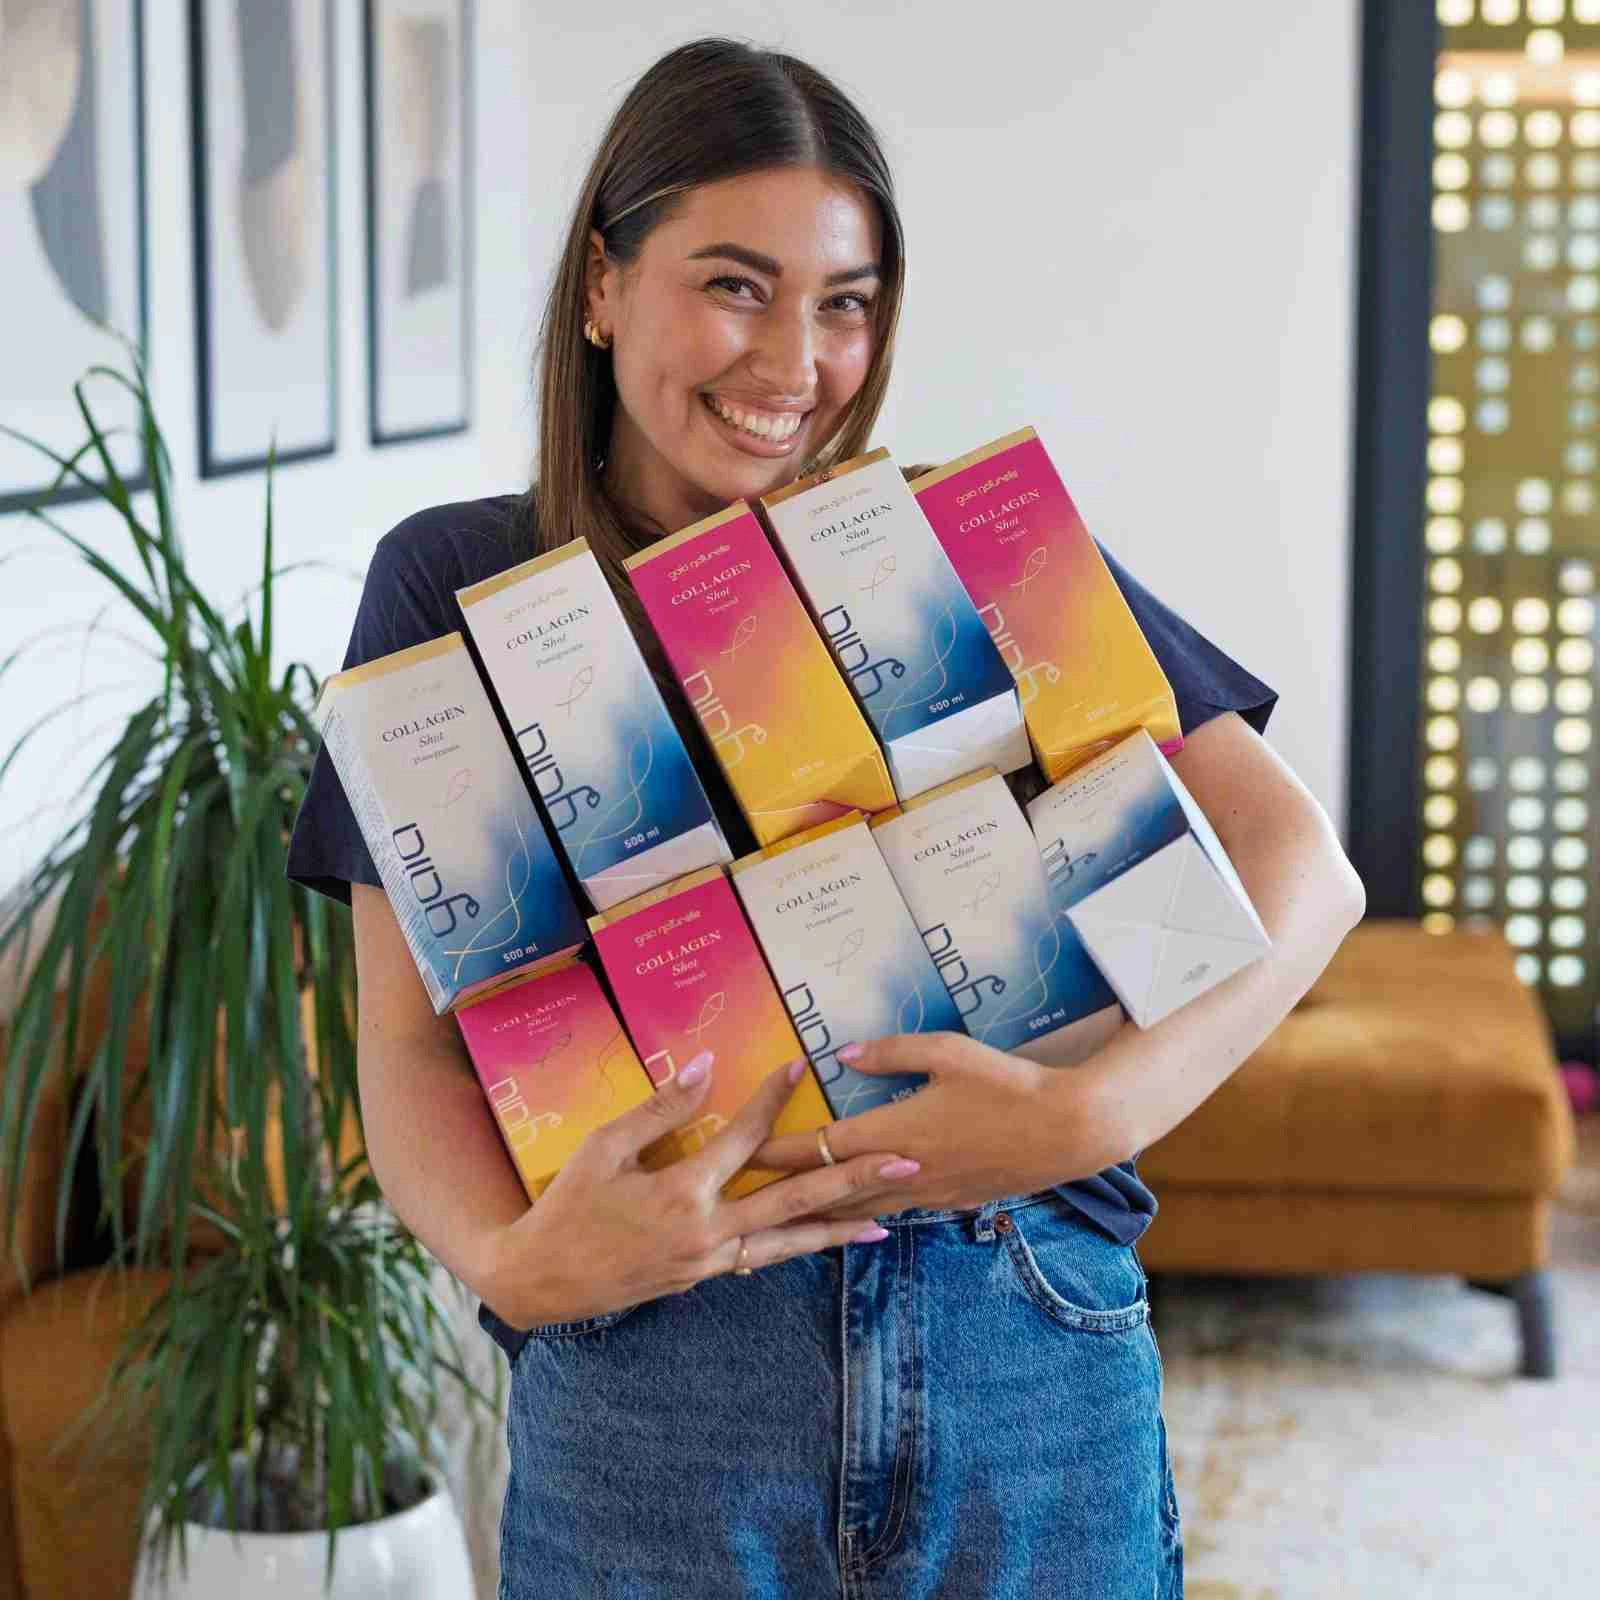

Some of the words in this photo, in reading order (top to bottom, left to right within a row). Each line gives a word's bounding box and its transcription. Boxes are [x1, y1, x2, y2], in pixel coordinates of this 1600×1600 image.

[810, 502, 893, 543] COLLAGEN
[959, 488, 1041, 534] COLLAGEN
[845, 526, 870, 544] Shot
[995, 515, 1020, 532] Shot
[671, 560, 753, 606] COLLAGEN
[705, 586, 730, 604] Shot
[506, 604, 591, 652] COLLAGEN
[542, 631, 568, 651] Shot
[928, 698, 951, 714] 500
[951, 693, 966, 708] ml
[382, 703, 467, 744] COLLAGEN
[418, 731, 445, 749] Shot
[624, 831, 645, 849] 500
[645, 826, 661, 842] ml
[914, 819, 999, 863] COLLAGEN
[775, 871, 862, 914] COLLAGEN
[503, 948, 524, 964] 500
[524, 942, 539, 957] ml
[635, 929, 721, 977] COLLAGEN
[671, 958, 698, 978] Shot
[492, 993, 578, 1034] COLLAGEN
[1028, 1014, 1050, 1031] 500
[1050, 1008, 1067, 1022] ml
